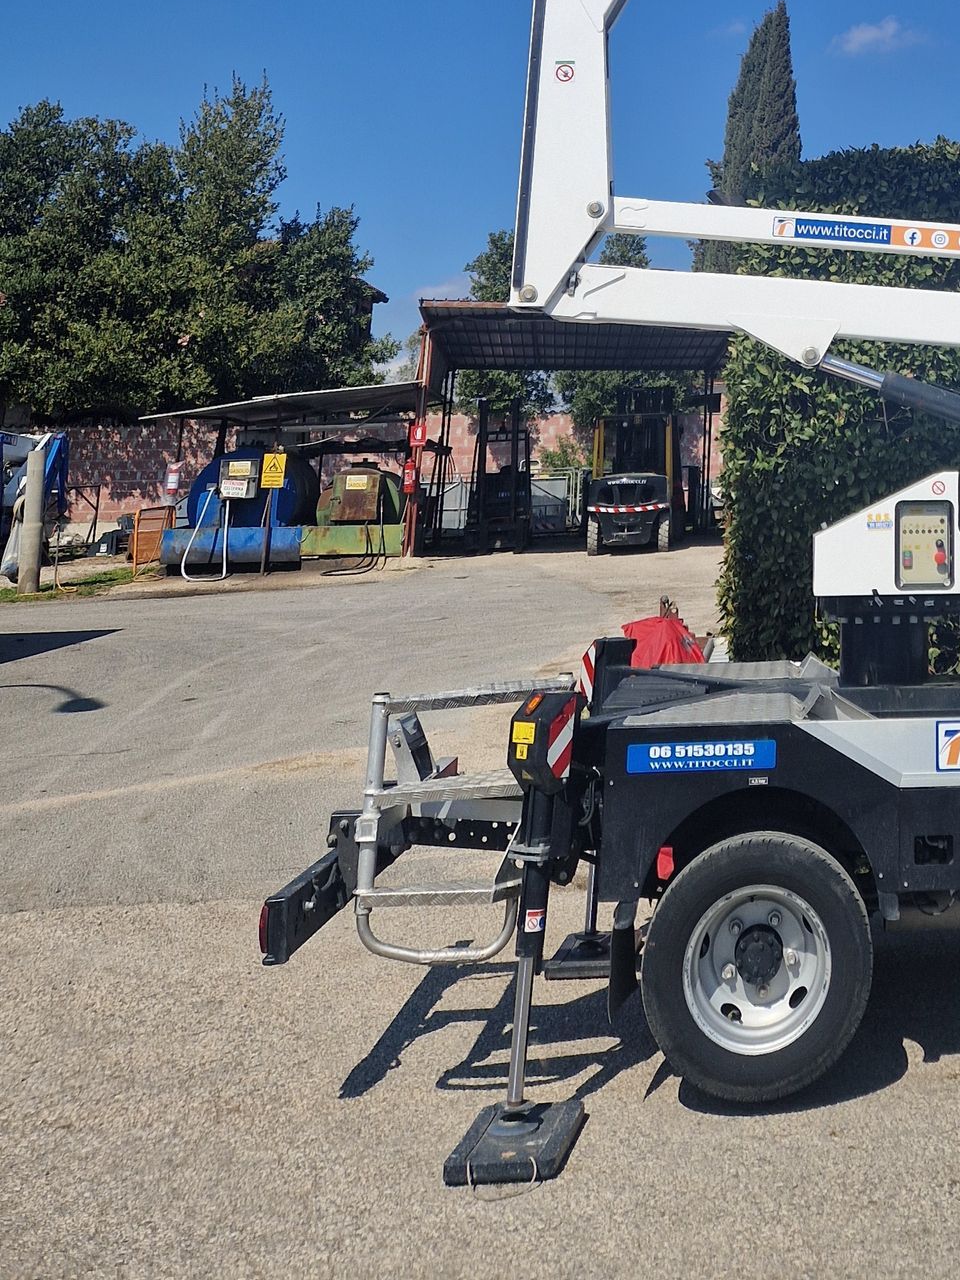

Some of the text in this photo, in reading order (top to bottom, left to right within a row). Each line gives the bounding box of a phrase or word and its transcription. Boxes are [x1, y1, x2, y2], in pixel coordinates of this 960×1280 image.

[797, 223, 889, 241] www.titocci.it
[650, 743, 755, 759] 06 51530135
[650, 758, 755, 770] WWW.TITOCCI.IT
